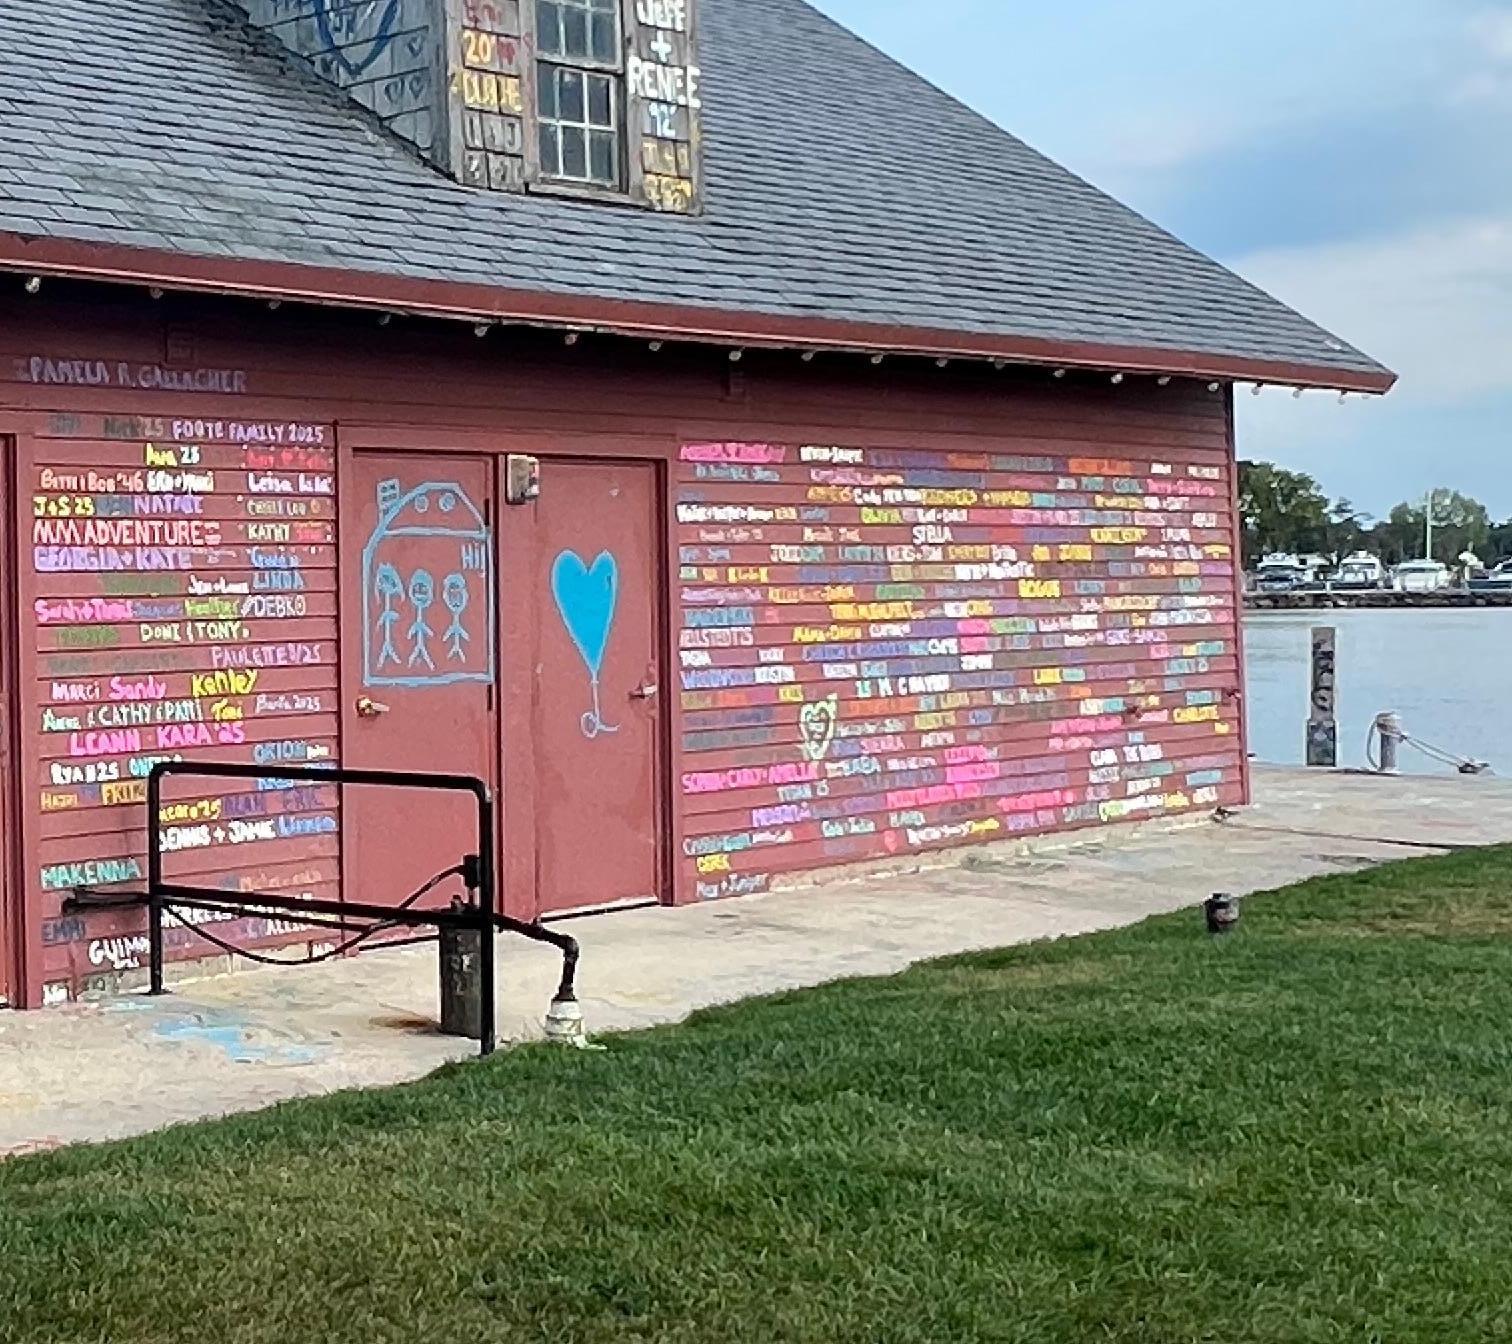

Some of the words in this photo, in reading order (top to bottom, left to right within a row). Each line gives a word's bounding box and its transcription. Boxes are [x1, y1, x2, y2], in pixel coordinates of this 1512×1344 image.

[98, 701, 152, 726] CATHY
[156, 723, 214, 749] KARA
[41, 858, 142, 888] MAKENNA
